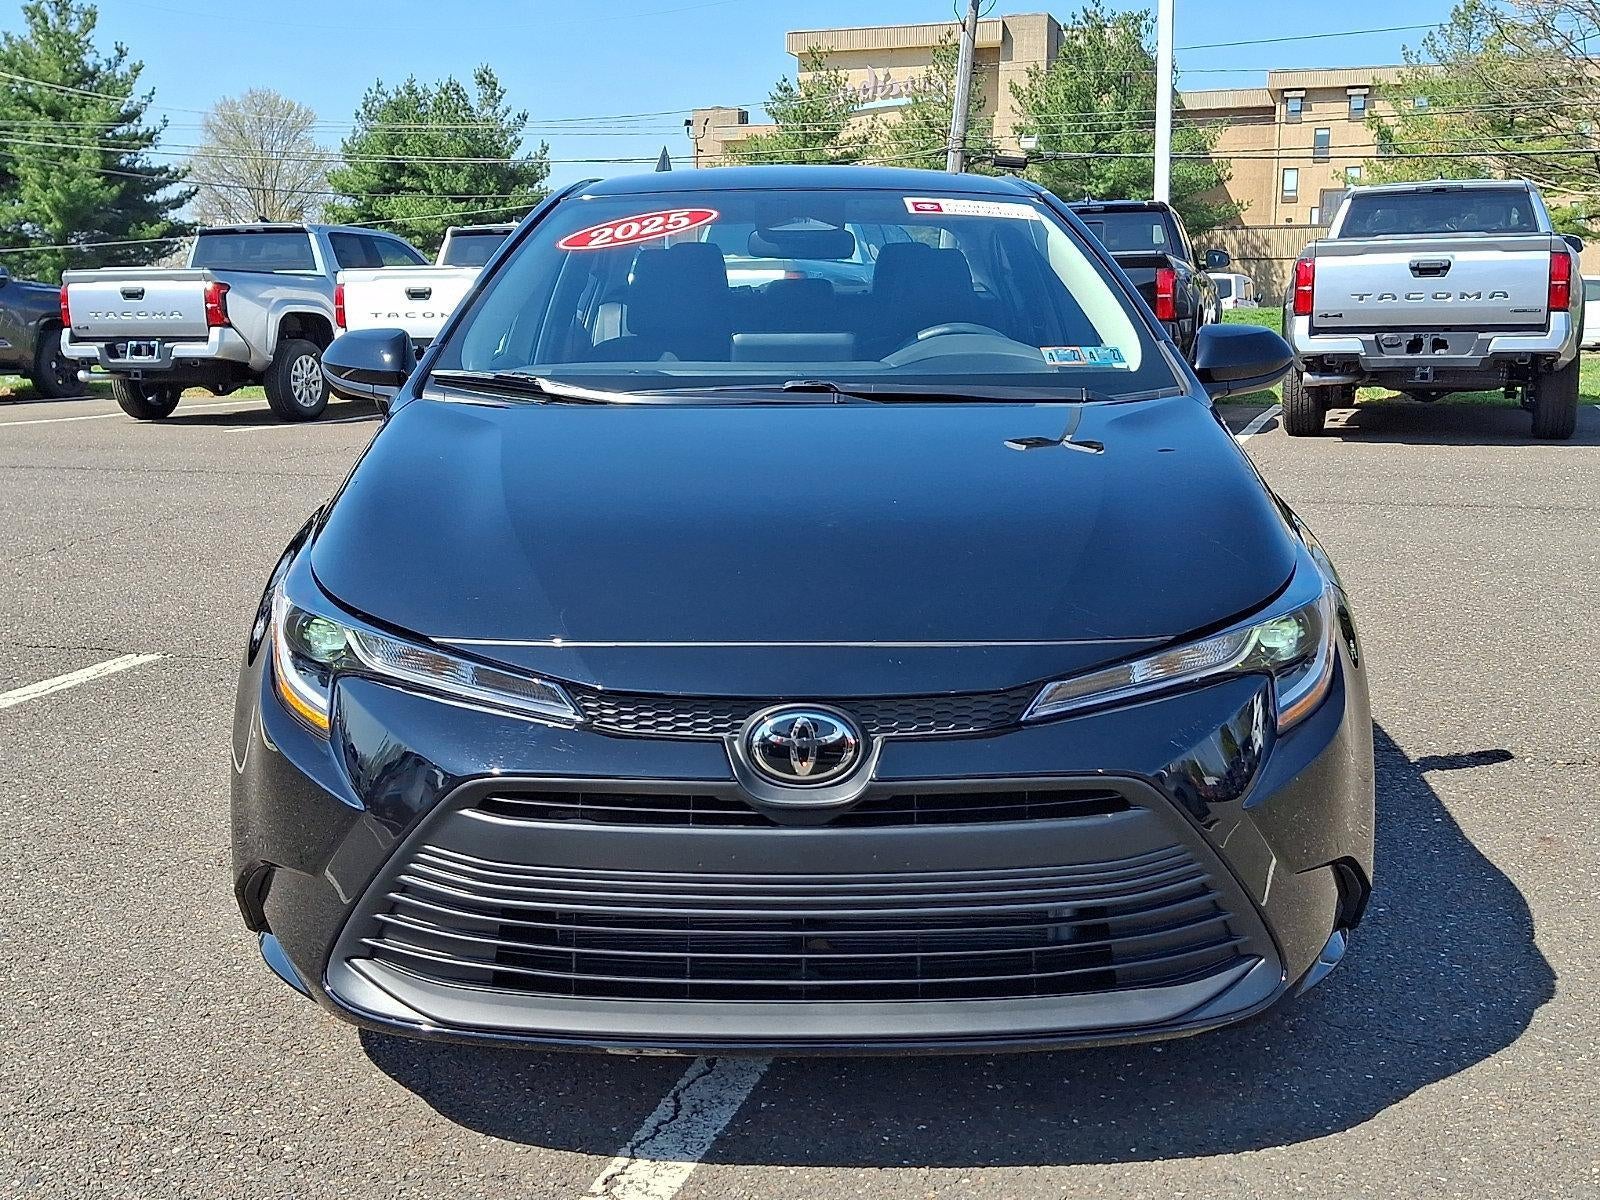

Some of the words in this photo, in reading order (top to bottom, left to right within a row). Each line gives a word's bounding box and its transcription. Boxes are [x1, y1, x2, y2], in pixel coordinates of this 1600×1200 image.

[588, 211, 690, 247] 2025
[1350, 291, 1510, 302] TACOMA
[88, 310, 183, 320] TACOMA
[370, 311, 450, 319] TACO
[1088, 350, 1097, 362] 4
